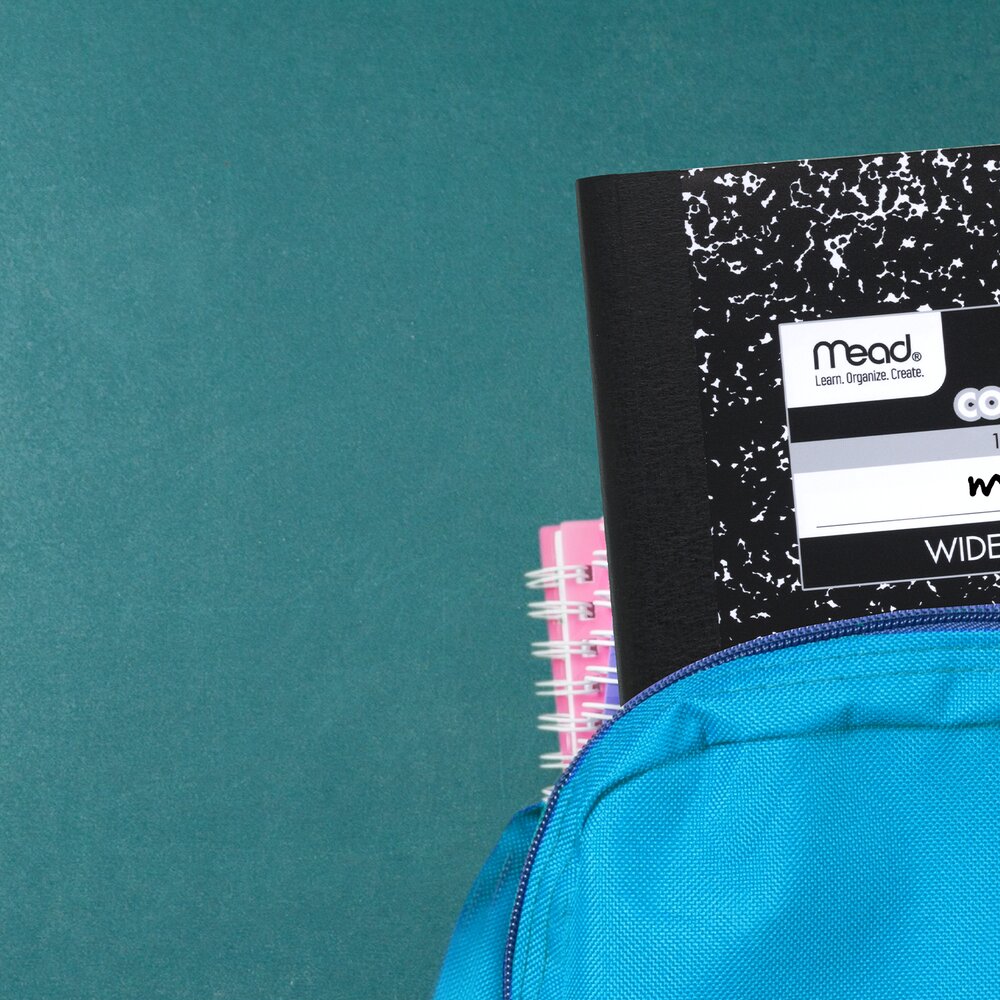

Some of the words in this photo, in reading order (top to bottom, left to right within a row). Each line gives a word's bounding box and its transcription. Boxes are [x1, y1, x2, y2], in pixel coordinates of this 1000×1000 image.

[815, 375, 845, 387] Learn.
[846, 370, 889, 386] Organize.
[891, 367, 924, 380] Create.
